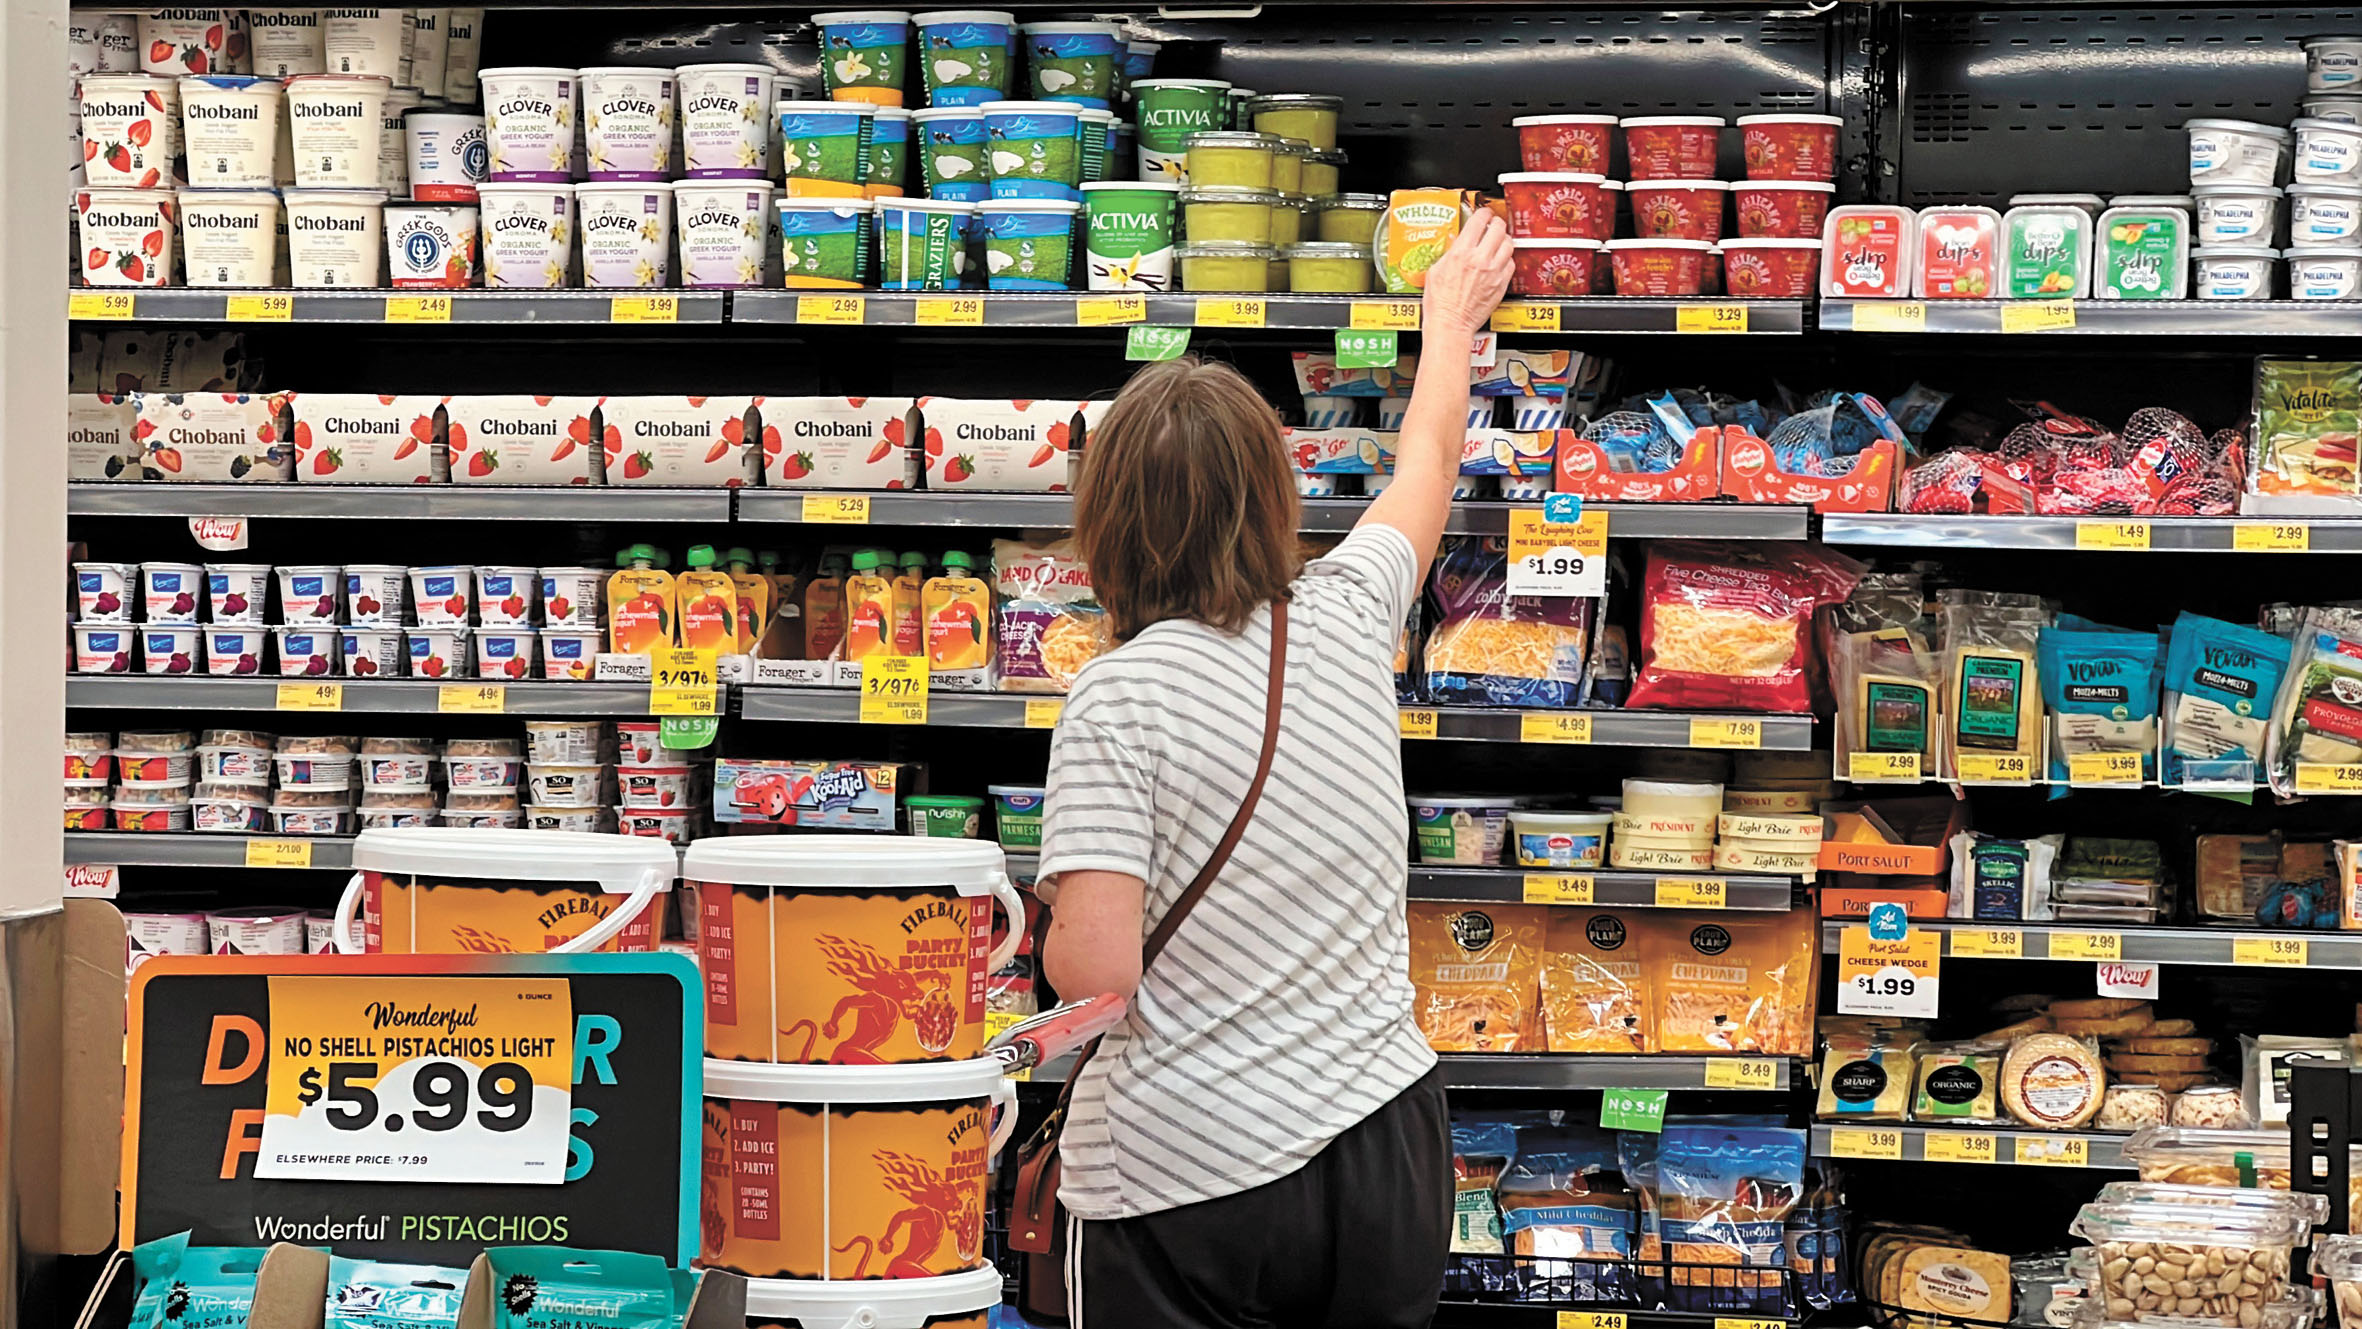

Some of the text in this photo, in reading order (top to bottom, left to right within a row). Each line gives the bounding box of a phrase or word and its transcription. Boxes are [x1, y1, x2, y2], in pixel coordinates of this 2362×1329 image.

[252, 13, 317, 27] Chobani
[2321, 58, 2358, 68] PHILADELPHIA
[499, 99, 552, 116] CLOVER
[602, 99, 656, 116] CLOVER
[688, 96, 739, 114] CLOVER
[941, 97, 965, 105] PLAIN
[82, 102, 145, 117] Chobani
[188, 104, 259, 120] Chobani
[294, 102, 363, 118] Chobani
[1144, 109, 1211, 126] ACTIVIA
[2308, 143, 2348, 156] PHILADELPHIA
[942, 192, 966, 200] PLAIN
[997, 189, 1018, 197] PLAIN
[87, 212, 159, 228] Chobani
[1396, 205, 1454, 219] WHOLLY
[2213, 209, 2253, 219] PHILADELPHIA
[2309, 209, 2350, 219] PHILADELPHIA
[188, 213, 259, 229] Chobani
[294, 215, 365, 231] Chobani
[495, 216, 548, 233] CLOVER
[587, 216, 638, 233] CLOVER
[687, 212, 740, 230] CLOVER
[1091, 213, 1159, 230] ACTIVIA
[1937, 242, 1983, 267] dips
[2023, 242, 2071, 267] dips
[2210, 271, 2250, 281] PHILADELPHIA
[1340, 337, 1393, 350] NOSH
[325, 416, 400, 435] Chobani
[480, 418, 557, 436] Chobani
[634, 420, 711, 438] Chobani
[794, 420, 872, 438] Chobani
[956, 423, 1036, 441] Chobani
[168, 427, 246, 445] Chobani
[1529, 558, 1584, 575] $1.99
[1711, 565, 1770, 582] SHREDDED
[1059, 569, 1092, 587] LAKE
[1663, 564, 1690, 579] Five
[1692, 569, 1741, 588] Cheese
[1743, 578, 1771, 592] Taco
[600, 664, 646, 678] Forager
[758, 667, 805, 679] Forager
[666, 719, 716, 731] NOSH
[876, 770, 890, 784] 12
[809, 771, 864, 803] Kool-Aid
[1737, 822, 1792, 835] Light Brie
[1629, 851, 1683, 865] Light Brie
[1753, 854, 1779, 868] Light
[1838, 852, 1912, 868] PORT SALUT
[901, 901, 968, 934] FIREBALL
[906, 938, 963, 955] PARTY
[899, 953, 967, 970] BUCKET
[1847, 957, 1928, 968] CHEESE WEDGE
[1858, 977, 1915, 995] $1.99
[364, 1001, 479, 1035] Wonderful
[284, 1037, 555, 1058] NO SHELL PISTACHIOS LIGHT
[1842, 1077, 1876, 1087] SHARP
[1932, 1080, 1976, 1090] ORGANIC
[297, 1061, 534, 1132] $5.99
[1608, 1097, 1660, 1114] NOSH
[741, 1119, 758, 1132] BUY
[742, 1141, 758, 1153] ADD
[761, 1142, 775, 1154] ICE
[276, 1154, 428, 1165] ELSEWHERE PRICE: $7.99
[743, 1162, 774, 1175] PARTY!
[1455, 1190, 1488, 1202] Blend
[1537, 1211, 1563, 1220] Mild
[256, 1215, 569, 1242] Wonderful PISTACHIOS
[513, 1283, 526, 1291] No
[1927, 1284, 1972, 1300] SPICY GOUDA
[1960, 1285, 1989, 1298] Cheese
[538, 1298, 620, 1318] Wonderful
